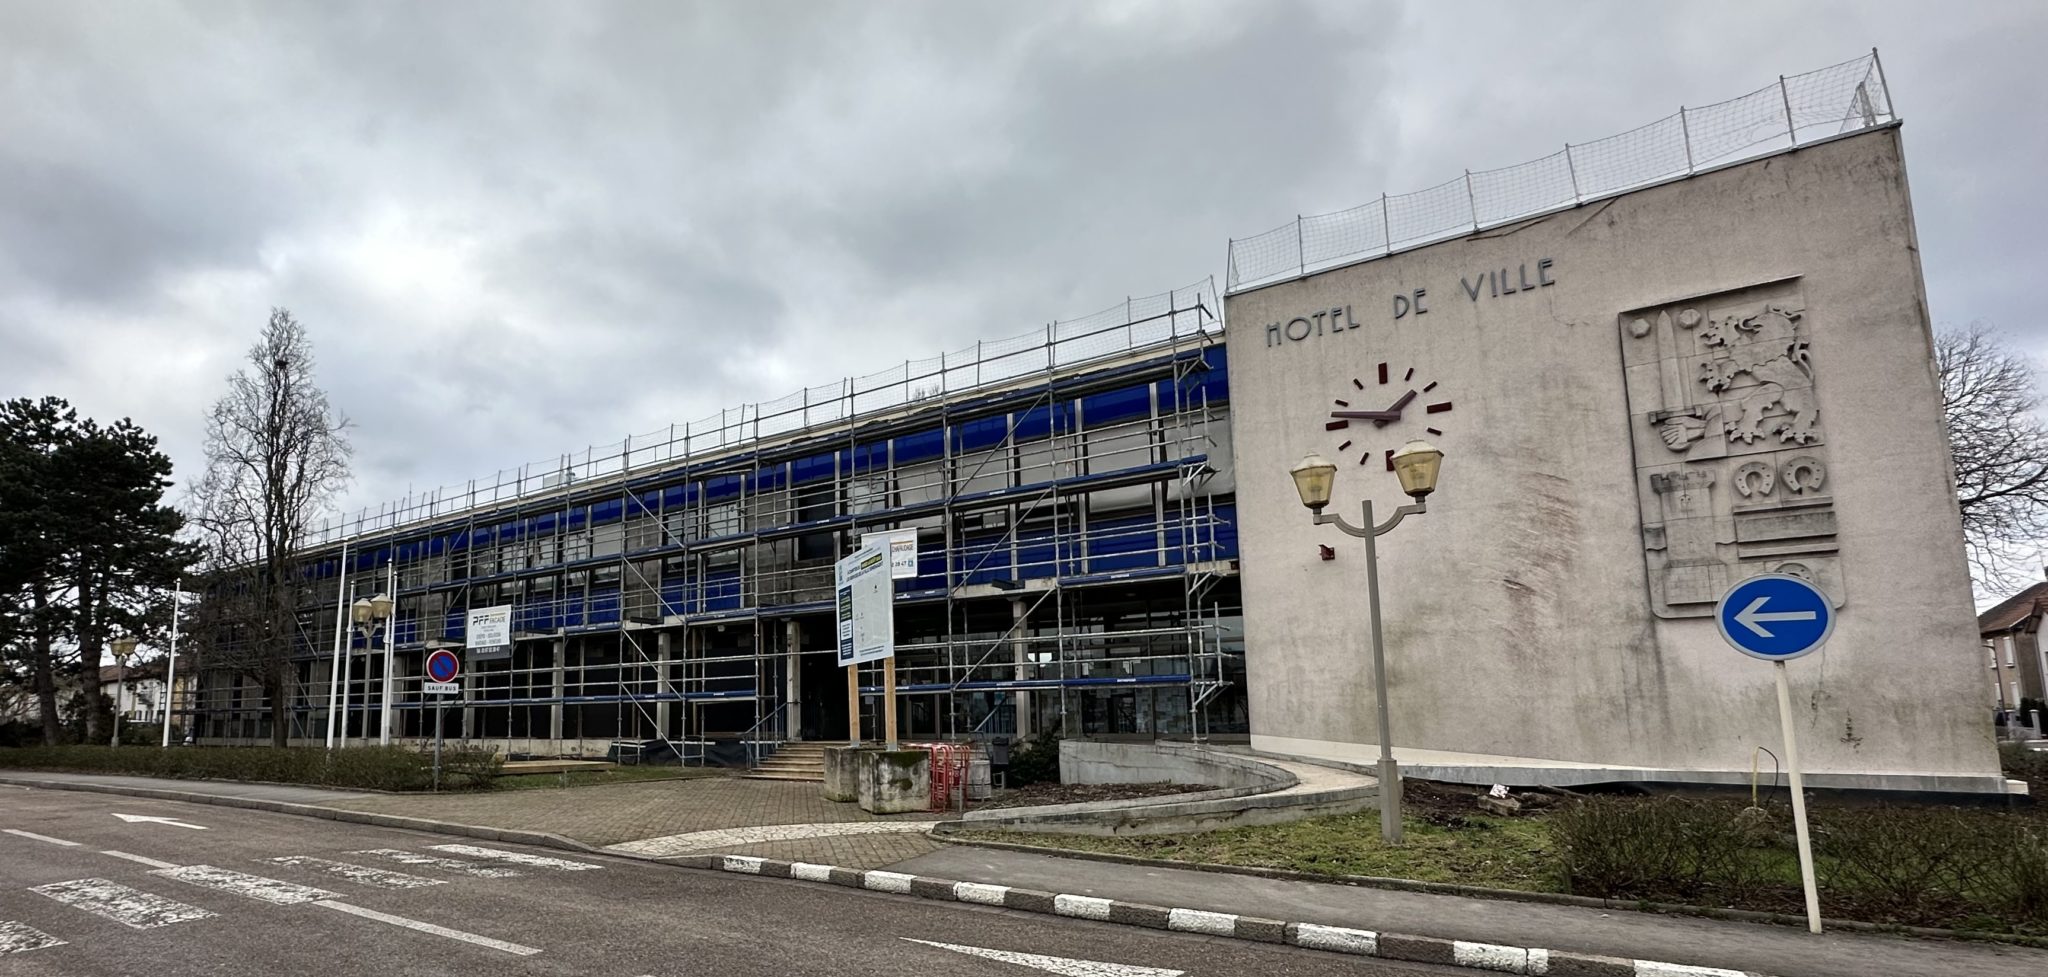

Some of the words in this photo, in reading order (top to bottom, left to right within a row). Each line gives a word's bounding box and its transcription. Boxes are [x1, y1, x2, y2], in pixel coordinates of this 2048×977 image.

[1266, 305, 1360, 347] HOTEL
[1393, 288, 1428, 319] DE
[1461, 258, 1555, 301] VILLE
[473, 614, 490, 626] PFF
